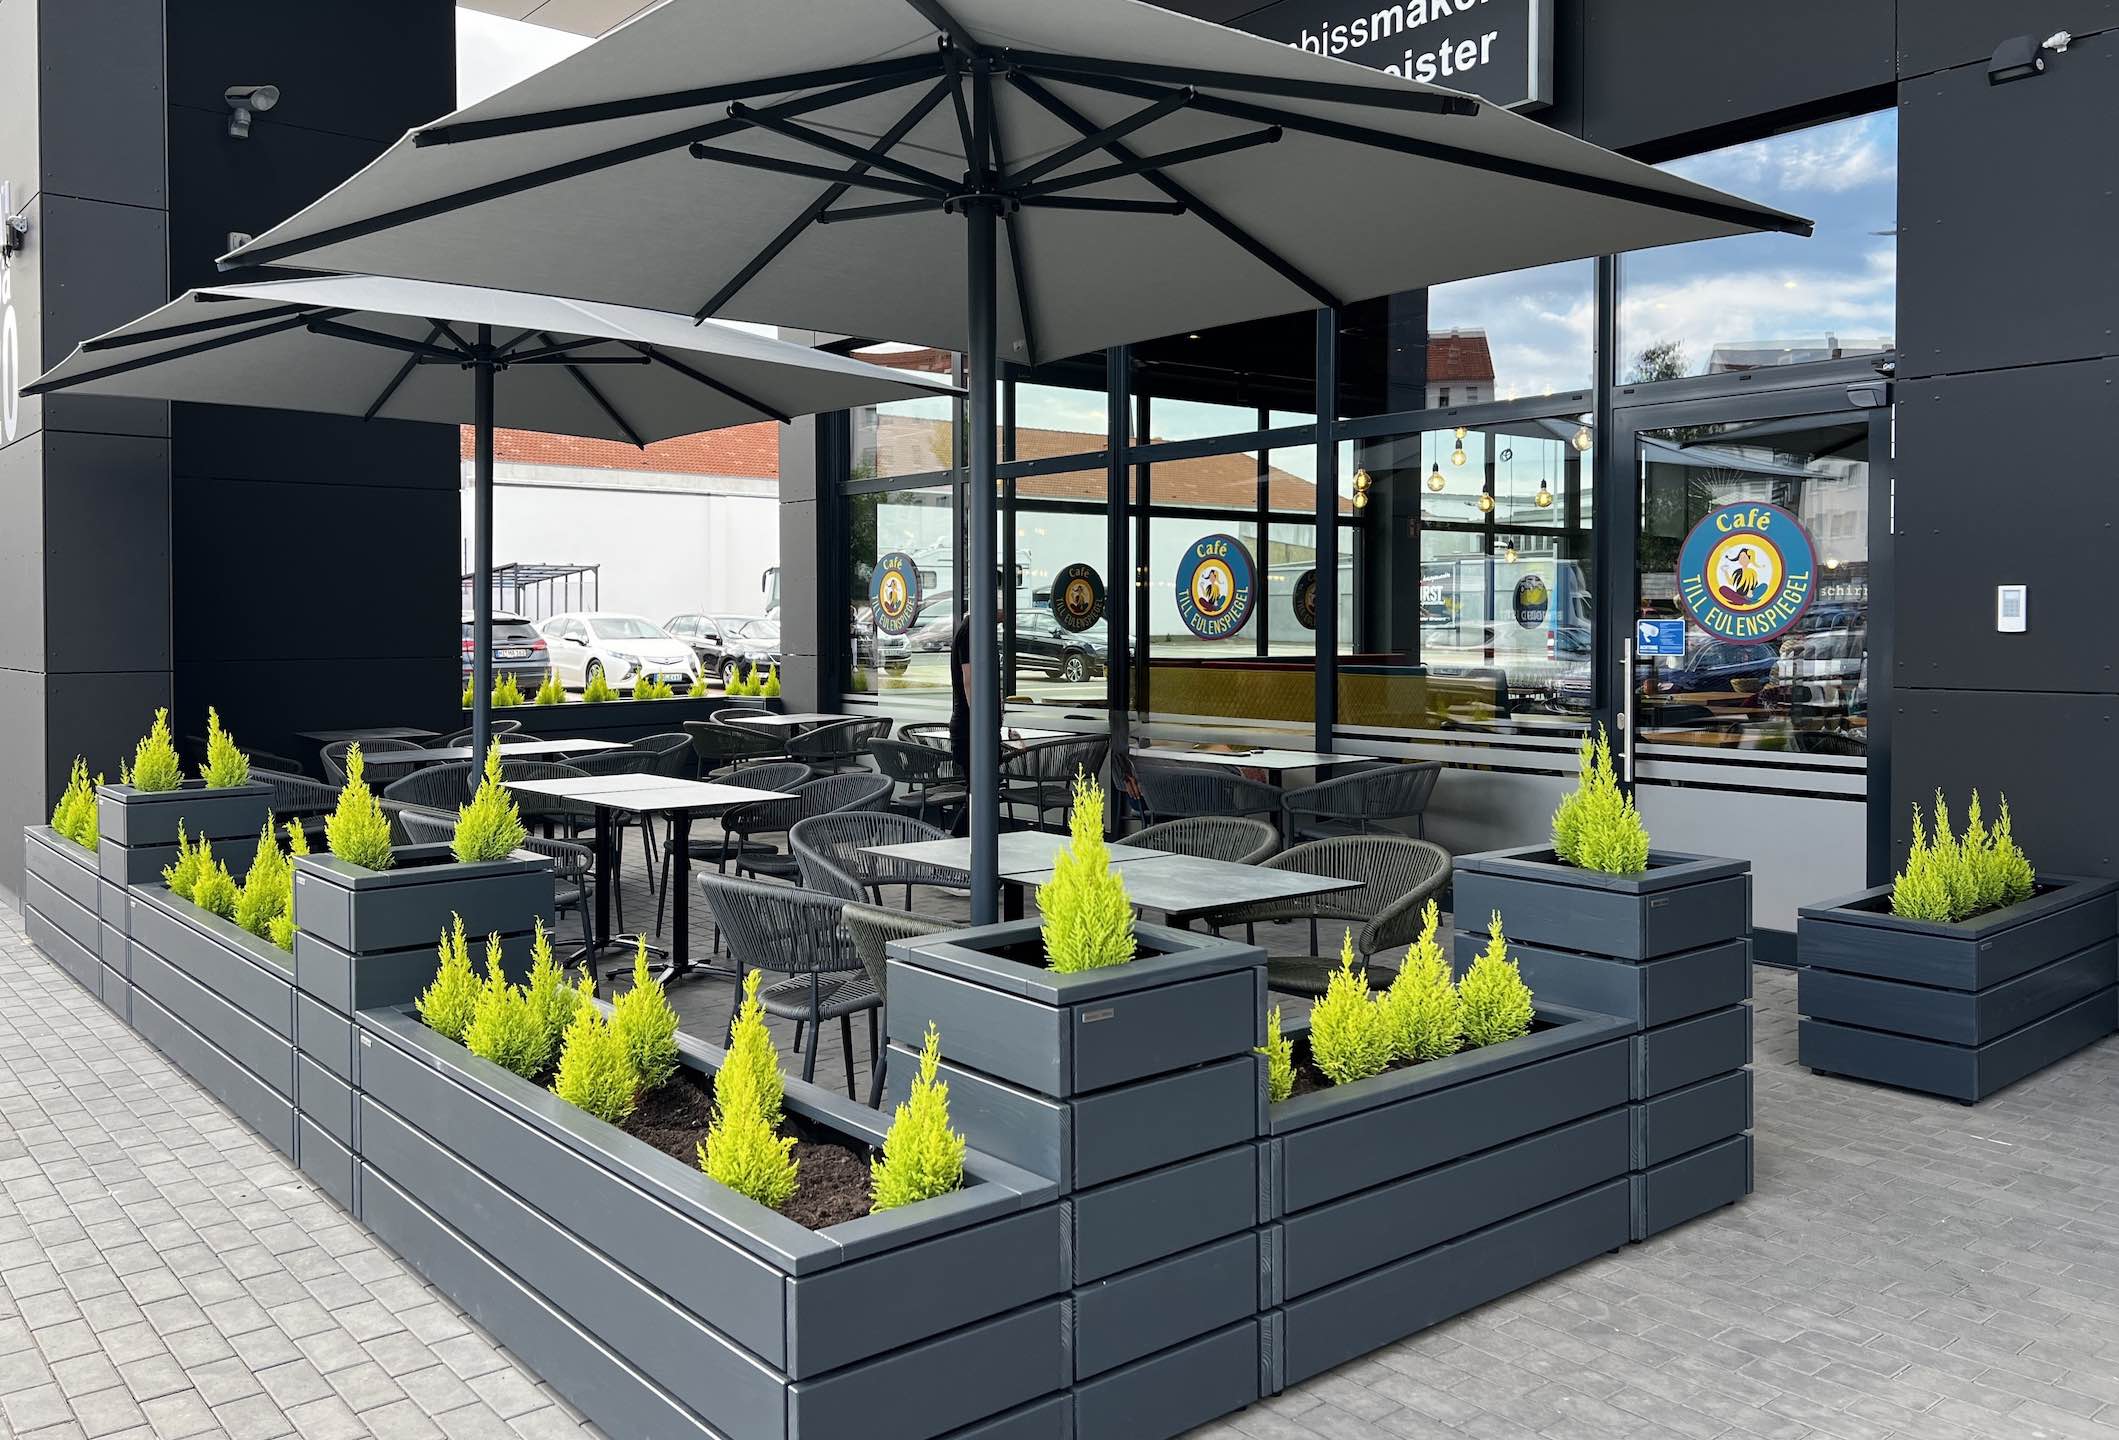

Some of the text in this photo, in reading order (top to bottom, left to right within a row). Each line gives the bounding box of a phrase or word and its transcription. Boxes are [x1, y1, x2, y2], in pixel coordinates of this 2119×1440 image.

[1716, 508, 1771, 532] Café
[1196, 540, 1228, 558] Café
[882, 557, 903, 570] Café
[1178, 586, 1249, 635] TILL EULENSPIEGEL
[1683, 571, 1809, 637] TILL EULENSPIEGEL
